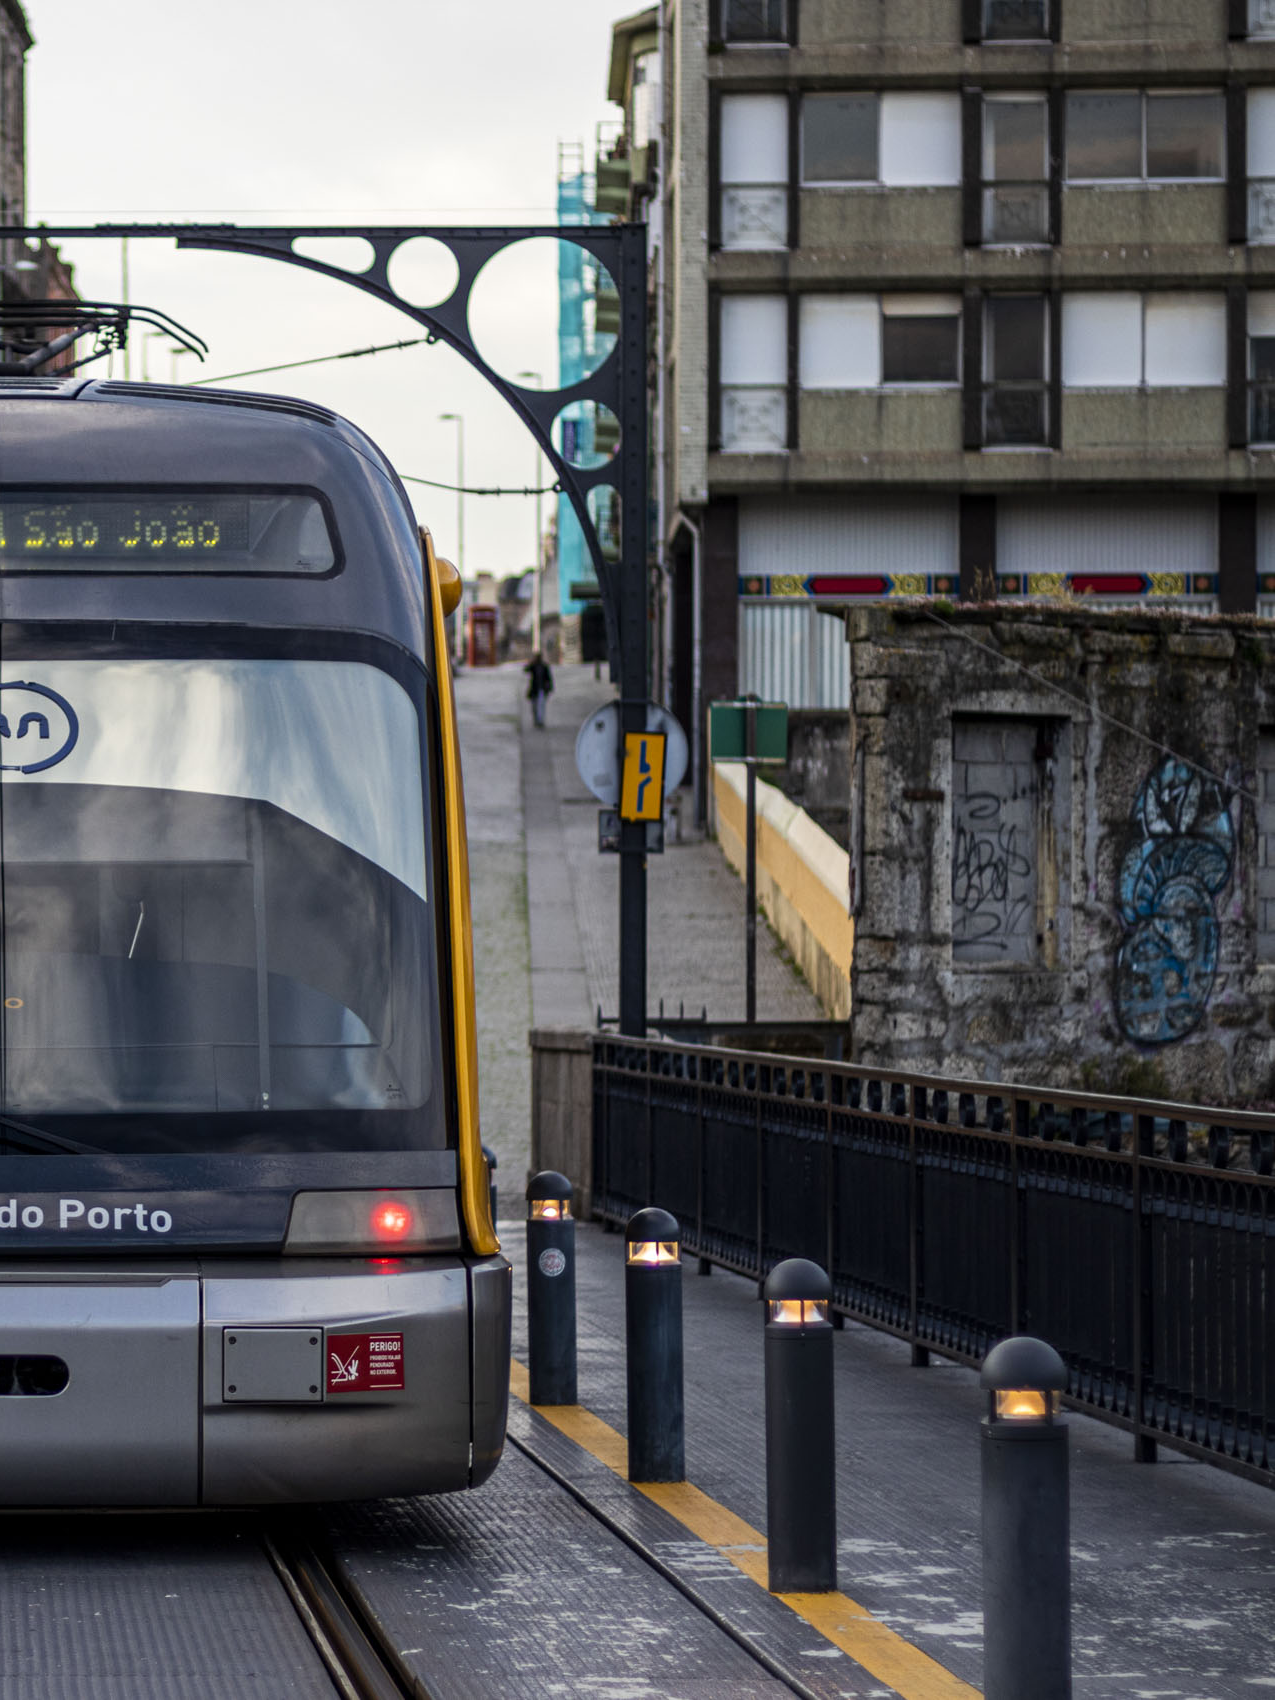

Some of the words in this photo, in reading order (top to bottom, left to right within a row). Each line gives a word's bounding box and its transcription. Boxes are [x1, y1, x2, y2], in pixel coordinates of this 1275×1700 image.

[24, 504, 99, 548] São
[59, 1199, 173, 1233] Porto
[369, 1341, 401, 1352] PERIGO!
